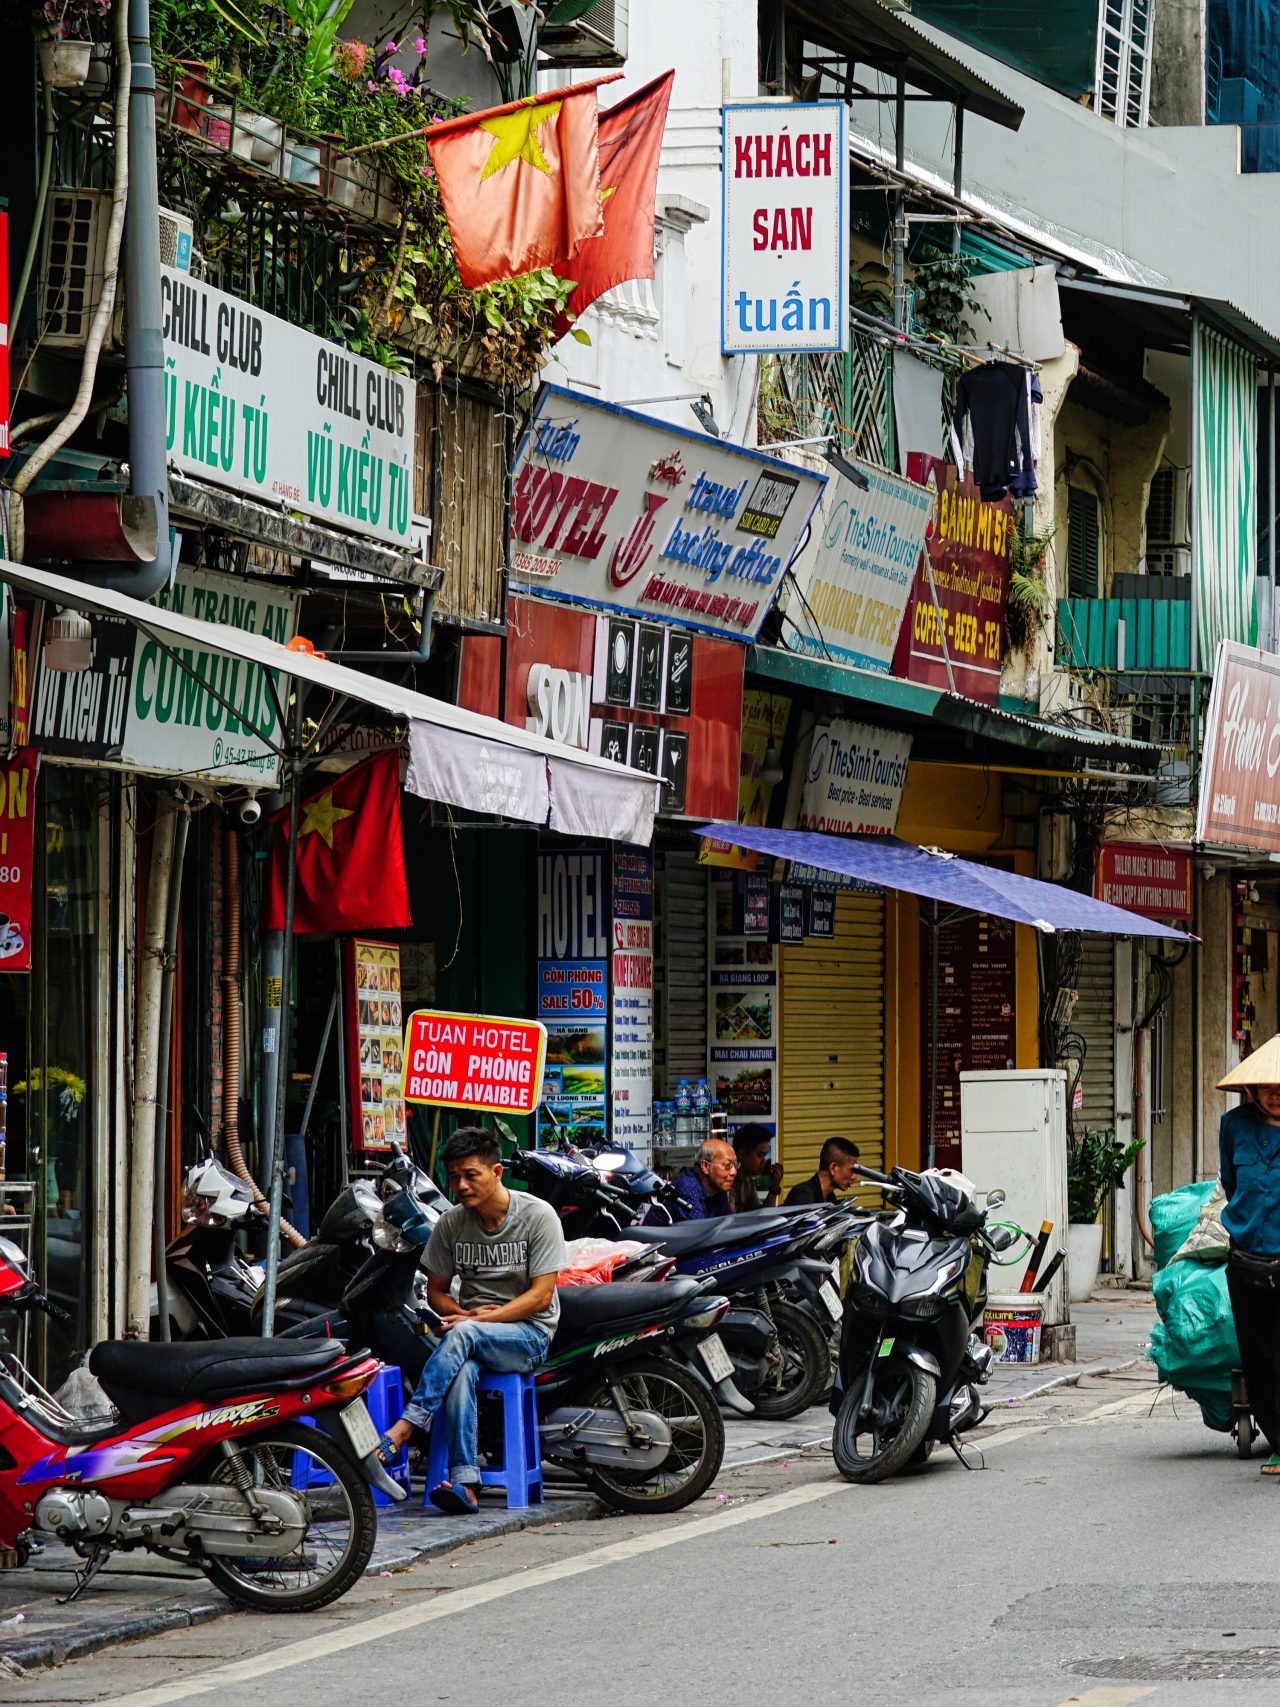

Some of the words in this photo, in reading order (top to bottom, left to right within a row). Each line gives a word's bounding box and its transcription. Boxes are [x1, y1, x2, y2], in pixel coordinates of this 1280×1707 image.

[734, 125, 832, 179] KHÁCH
[752, 207, 813, 260] SẠN
[160, 275, 210, 357] CHILL
[217, 302, 263, 377] CLUB
[734, 280, 832, 333] tuấn
[316, 347, 361, 421] CHILL
[366, 370, 405, 439] CLUB
[163, 356, 177, 451] Ũ
[183, 366, 236, 473] KIỀU
[242, 394, 268, 484] TÚ
[307, 422, 333, 508] VŨ
[338, 428, 383, 526] KIỀU
[388, 453, 409, 537] TÚ
[686, 470, 749, 520] travel
[510, 462, 620, 560] HOTEL
[939, 480, 976, 547] BÁNH
[993, 508, 1007, 558] 51
[662, 517, 730, 583] booking
[729, 538, 781, 585] office
[192, 586, 257, 634] TRANG
[261, 604, 289, 646] AN
[805, 579, 863, 634] BOOKING
[858, 597, 900, 648] OFFICE
[914, 600, 947, 645] COFFEE
[954, 613, 977, 655] BEER
[983, 620, 1000, 661] TEA
[103, 657, 128, 745] Tú
[135, 640, 280, 739] CUMULUS
[1222, 677, 1272, 773] Hanoi
[827, 739, 908, 789] TheSinhTourist
[827, 782, 841, 800] Best
[841, 786, 856, 805] price
[858, 788, 871, 807] Best
[871, 792, 893, 811] services
[1114, 854, 1131, 877] TAILOR
[1131, 856, 1146, 878] MADE
[1146, 857, 1153, 879] IN
[1153, 858, 1160, 880] 10
[1160, 859, 1177, 880] HOURS
[537, 853, 608, 960] HOTEL
[1112, 883, 1123, 905] CAN
[1123, 884, 1137, 905] COPY
[1137, 886, 1162, 907] ANYTHING
[1162, 888, 1172, 908] YOU
[1172, 888, 1186, 909] WANT
[542, 995, 568, 1009] SALE
[570, 989, 604, 1009] 50%
[543, 966, 565, 983] CÒN
[566, 965, 602, 983] PHÒNG
[728, 974, 752, 984] GIANG
[753, 973, 769, 984] LOOP
[417, 1021, 467, 1045] TUAN
[473, 1027, 533, 1053] HOTEL
[564, 1026, 588, 1034] GIANG
[714, 1049, 727, 1060] MAI
[728, 1049, 747, 1060] CHAU
[748, 1049, 773, 1060] NATURE
[413, 1045, 452, 1075] CÒN
[467, 1052, 531, 1083] PHÒNG
[409, 1077, 458, 1100] ROOM
[461, 1082, 529, 1107] AVAIBLE
[582, 1094, 597, 1102] TREK
[455, 1240, 528, 1266] COLUMBINE
[195, 1404, 265, 1431] Wave
